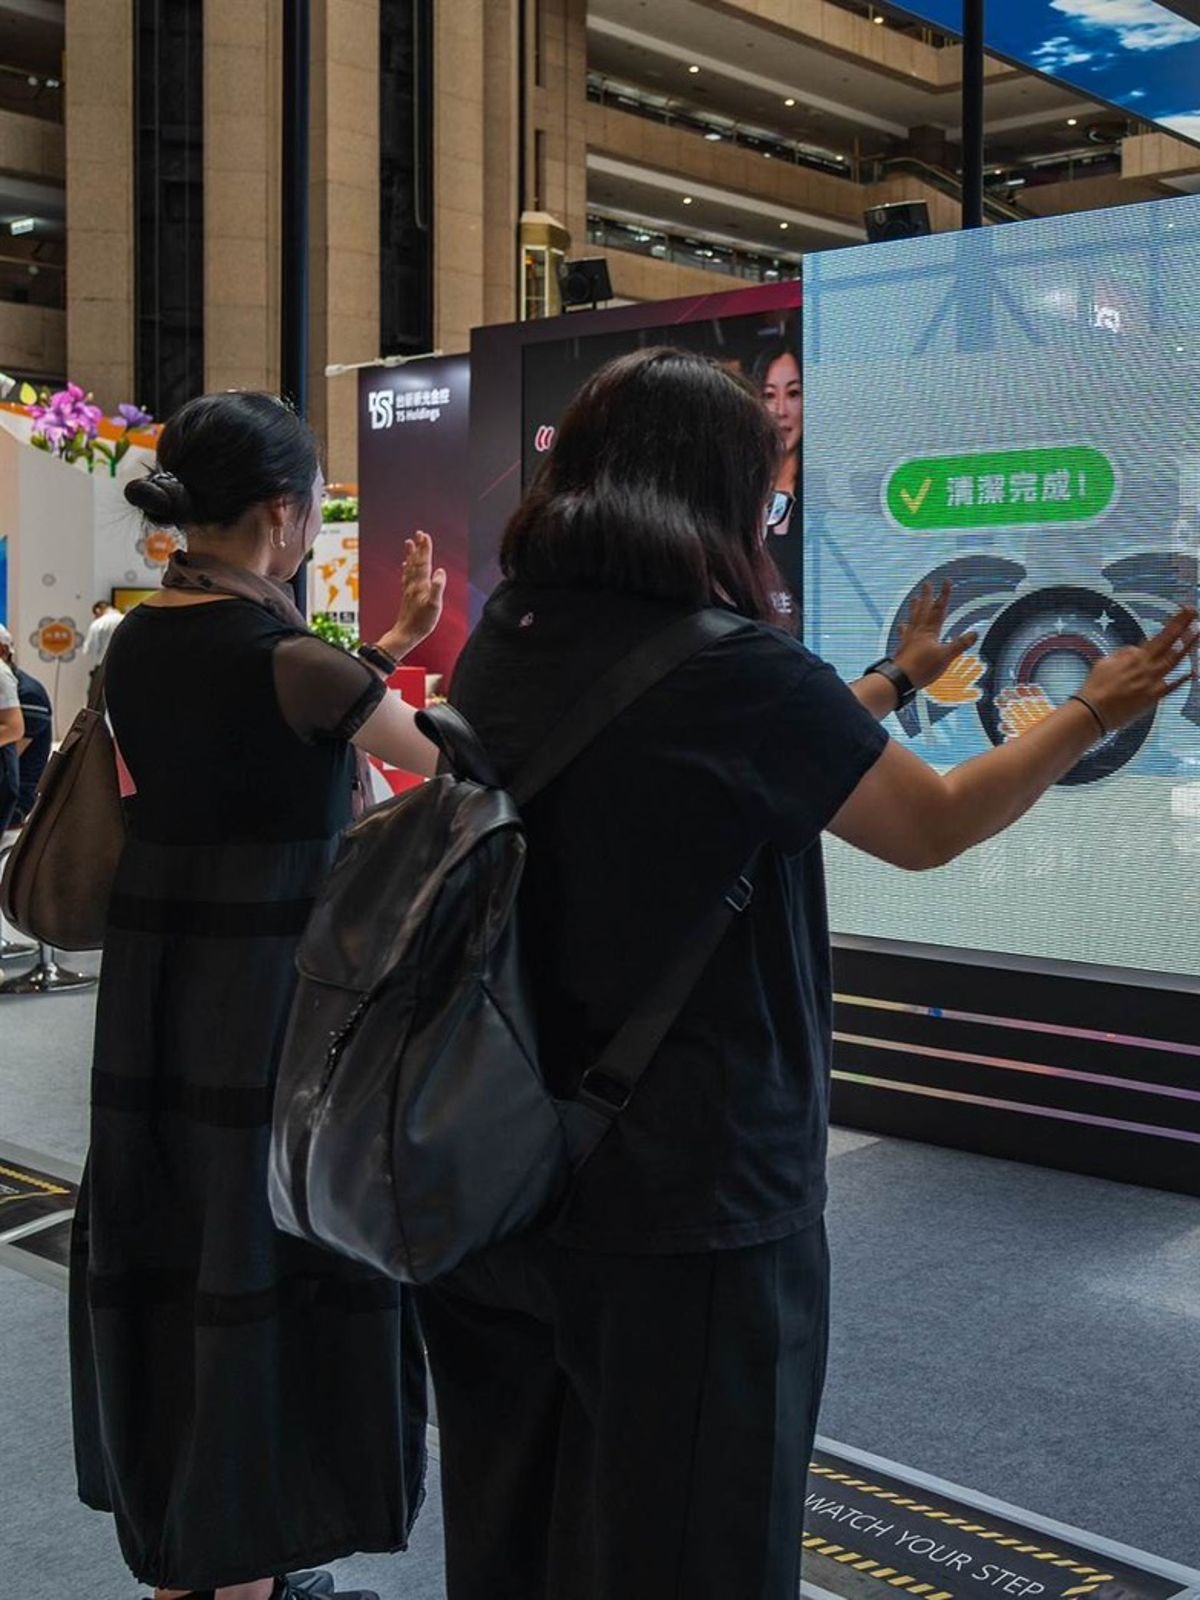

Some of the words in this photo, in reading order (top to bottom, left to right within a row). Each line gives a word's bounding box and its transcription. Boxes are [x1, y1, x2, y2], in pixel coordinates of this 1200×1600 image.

[406, 406, 441, 422] Holdings
[804, 1493, 894, 1537] WATCH
[895, 1530, 972, 1571] YOUR
[972, 1564, 1045, 1598] STEP
